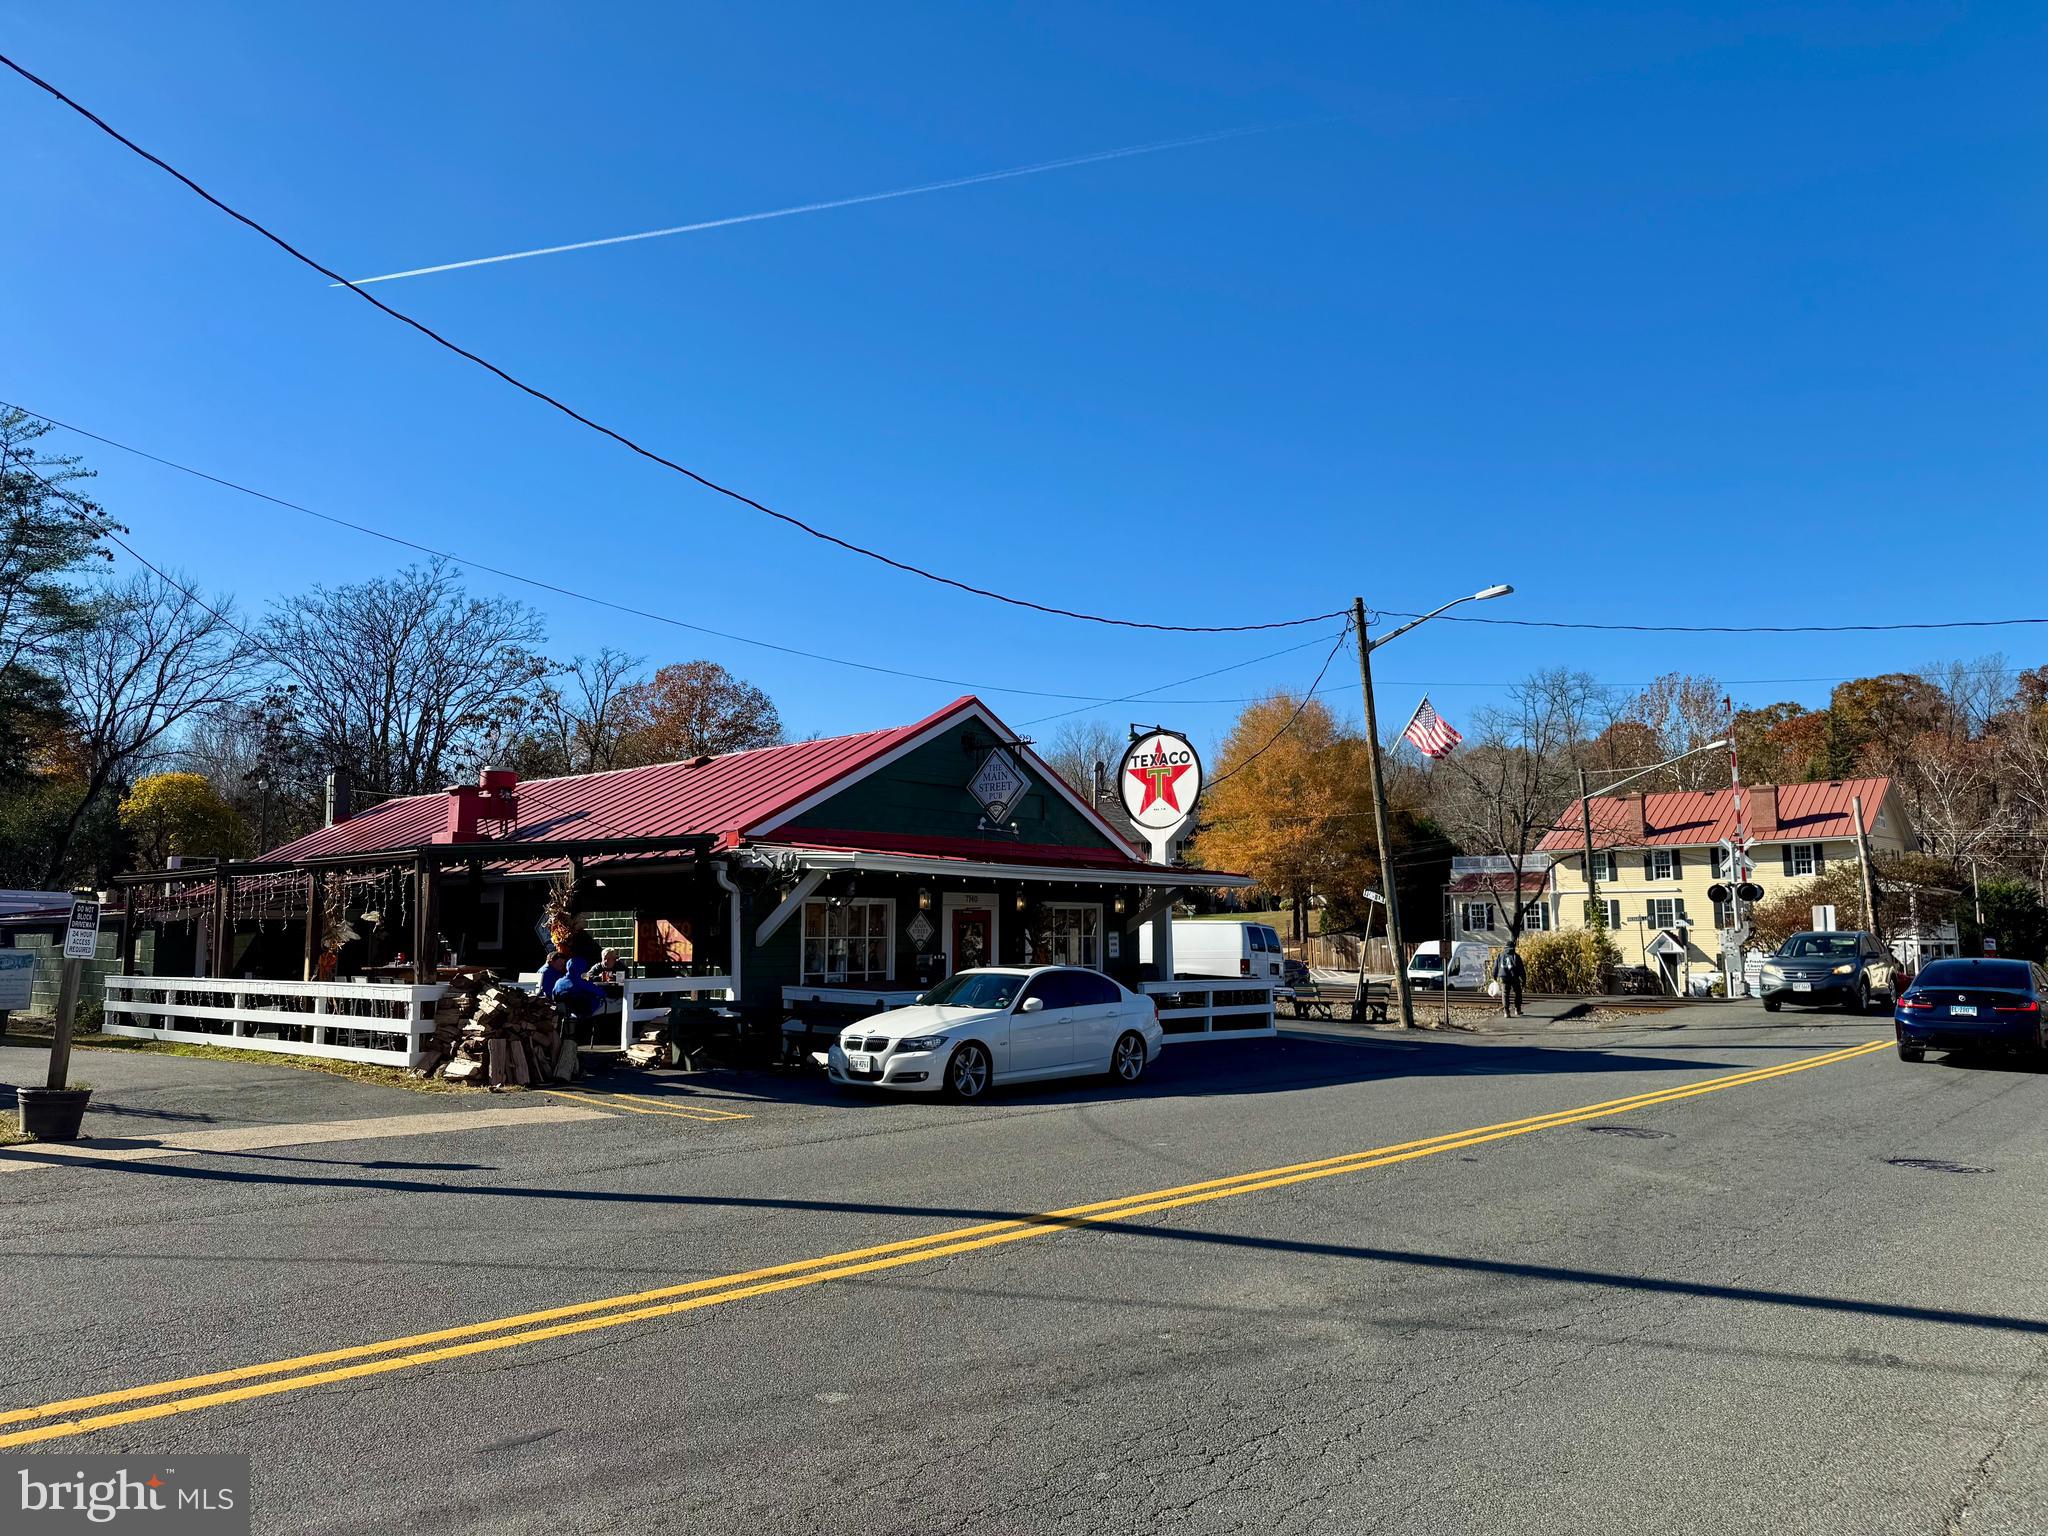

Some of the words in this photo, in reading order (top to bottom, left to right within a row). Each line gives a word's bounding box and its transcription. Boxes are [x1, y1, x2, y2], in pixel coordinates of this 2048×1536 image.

[1131, 750, 1190, 768] TEXACO
[988, 763, 1003, 772] THE
[982, 771, 1008, 782] MAIN
[978, 781, 1013, 793] STREET
[988, 792, 1003, 800] PUB
[76, 913, 93, 921] BLOCK
[71, 920, 96, 929] DRIVEWAY
[72, 930, 79, 938] 24
[72, 938, 91, 946] ACCESS
[68, 945, 92, 954] REQUIRED
